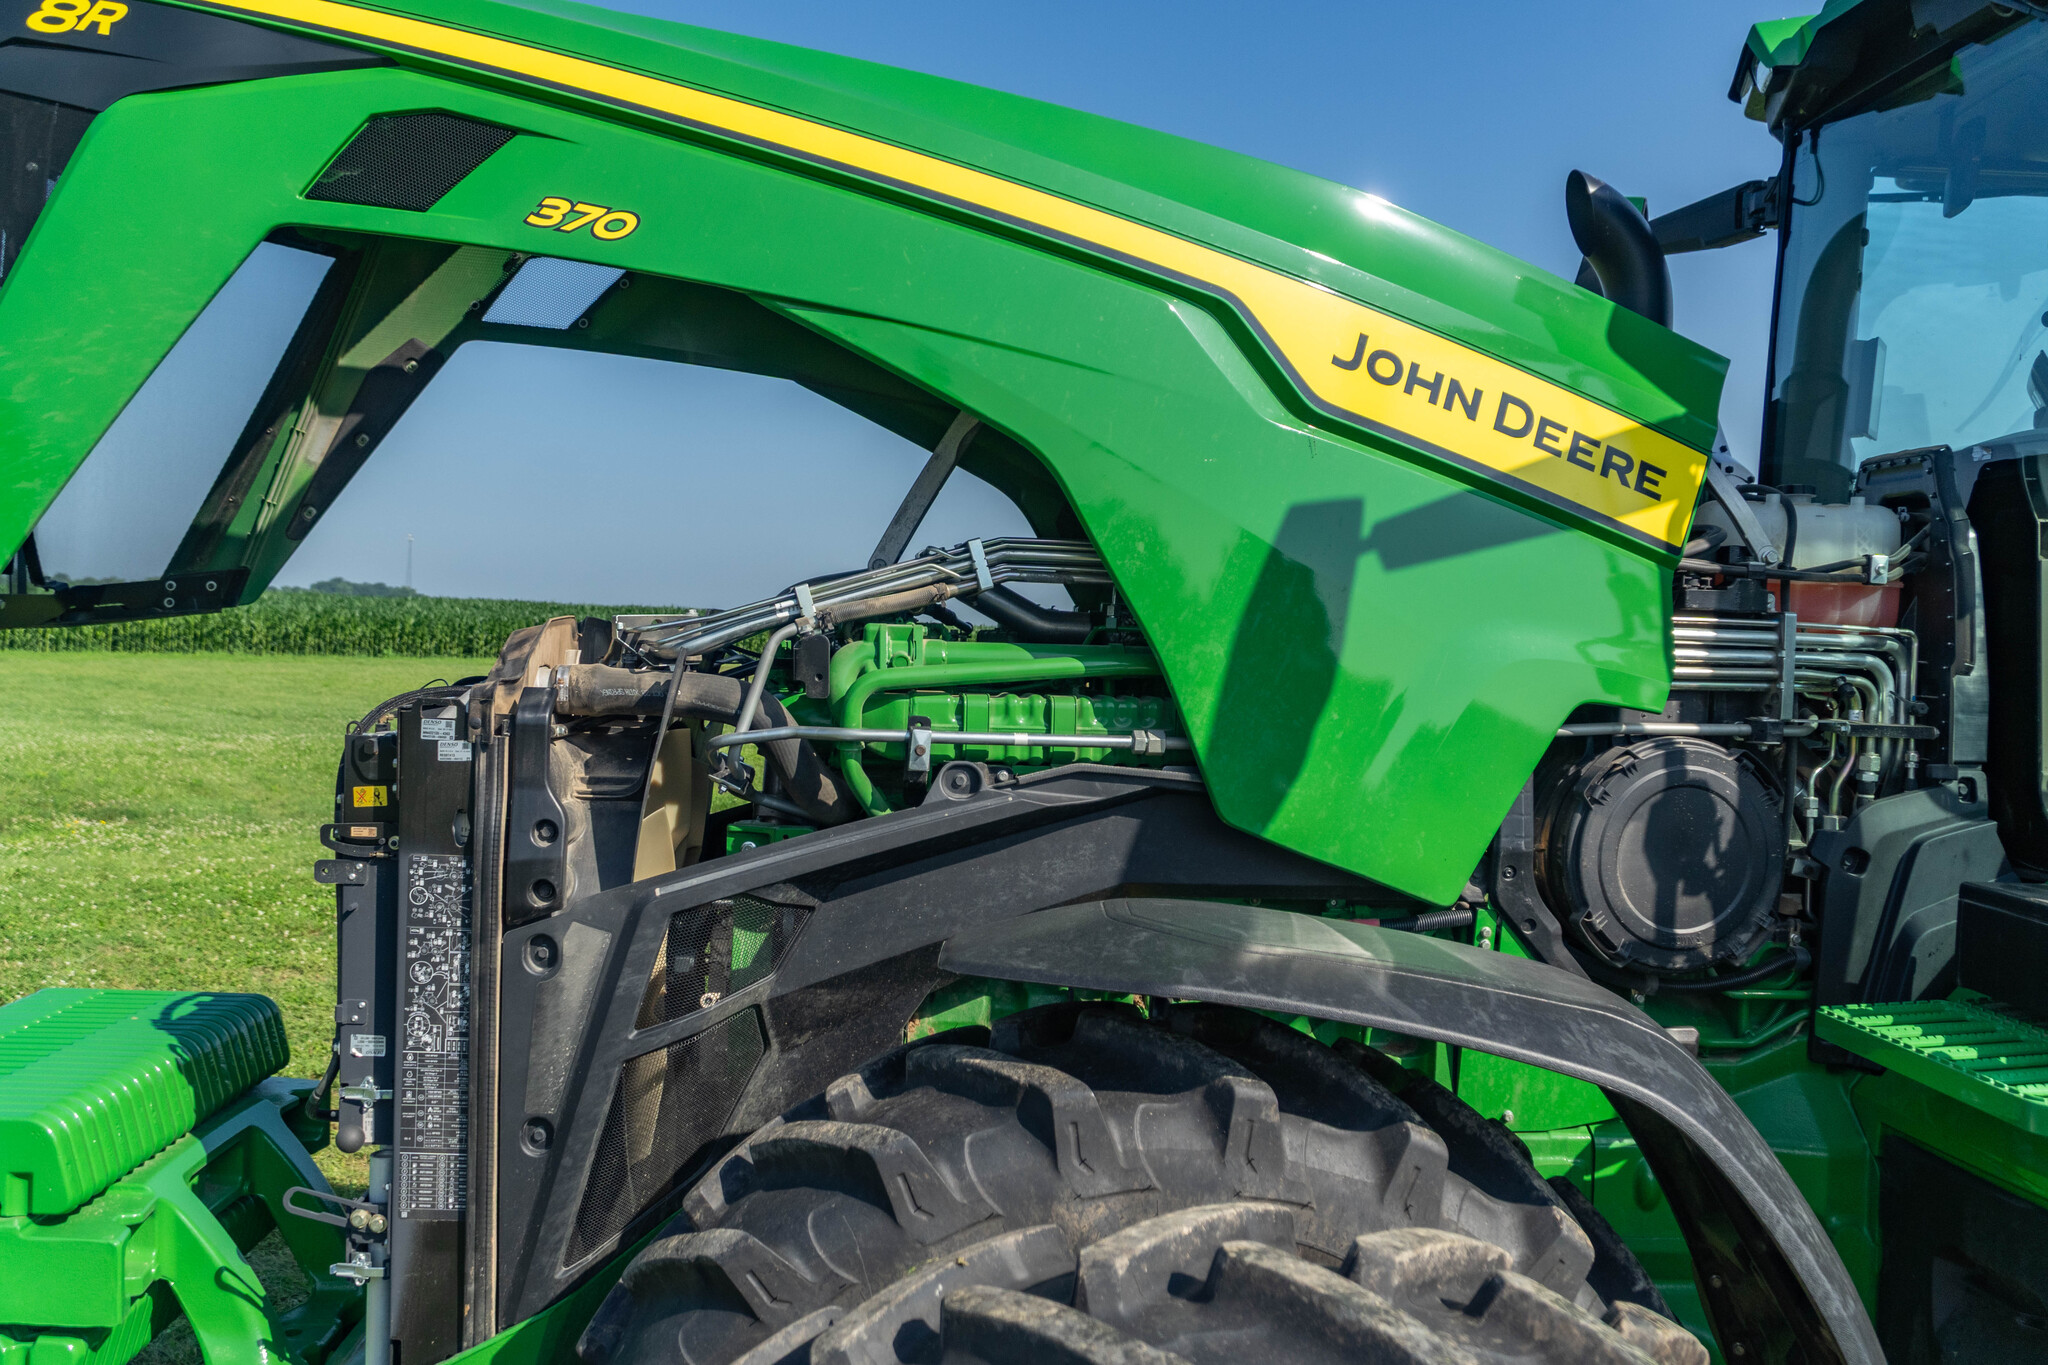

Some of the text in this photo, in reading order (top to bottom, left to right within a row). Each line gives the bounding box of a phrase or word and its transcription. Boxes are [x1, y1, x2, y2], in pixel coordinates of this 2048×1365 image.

[26, 0, 129, 35] 8R
[523, 196, 641, 241] 370
[1331, 332, 1667, 502] JOHN DEERE
